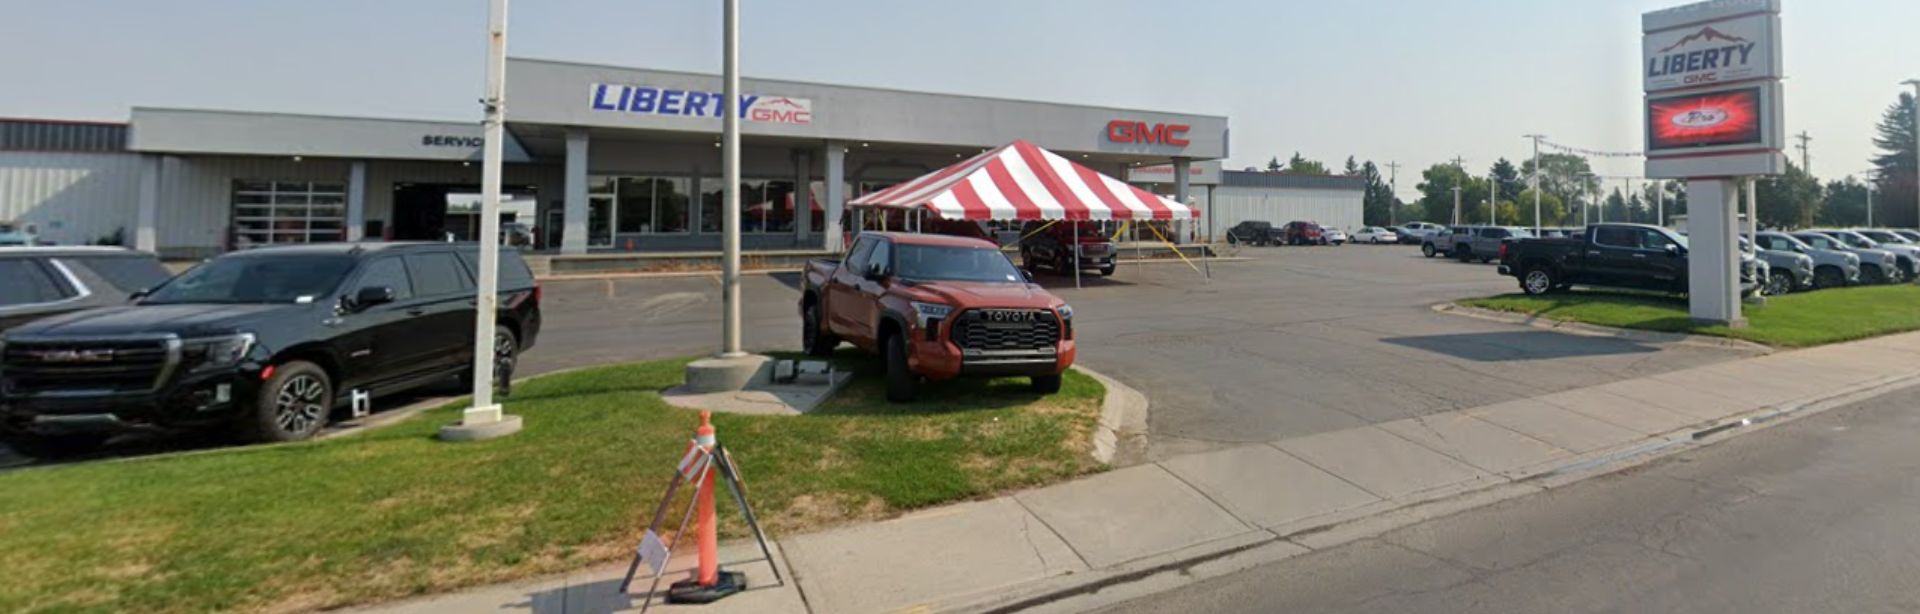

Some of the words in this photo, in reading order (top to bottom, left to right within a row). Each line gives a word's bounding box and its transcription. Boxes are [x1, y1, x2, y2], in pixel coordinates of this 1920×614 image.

[1648, 42, 1755, 77] LIBERTY
[1683, 72, 1718, 84] GMC
[752, 108, 811, 124] GMC
[1107, 119, 1190, 147] GMC
[423, 134, 485, 147] SERVIC
[986, 311, 1036, 321] TOYOTA
